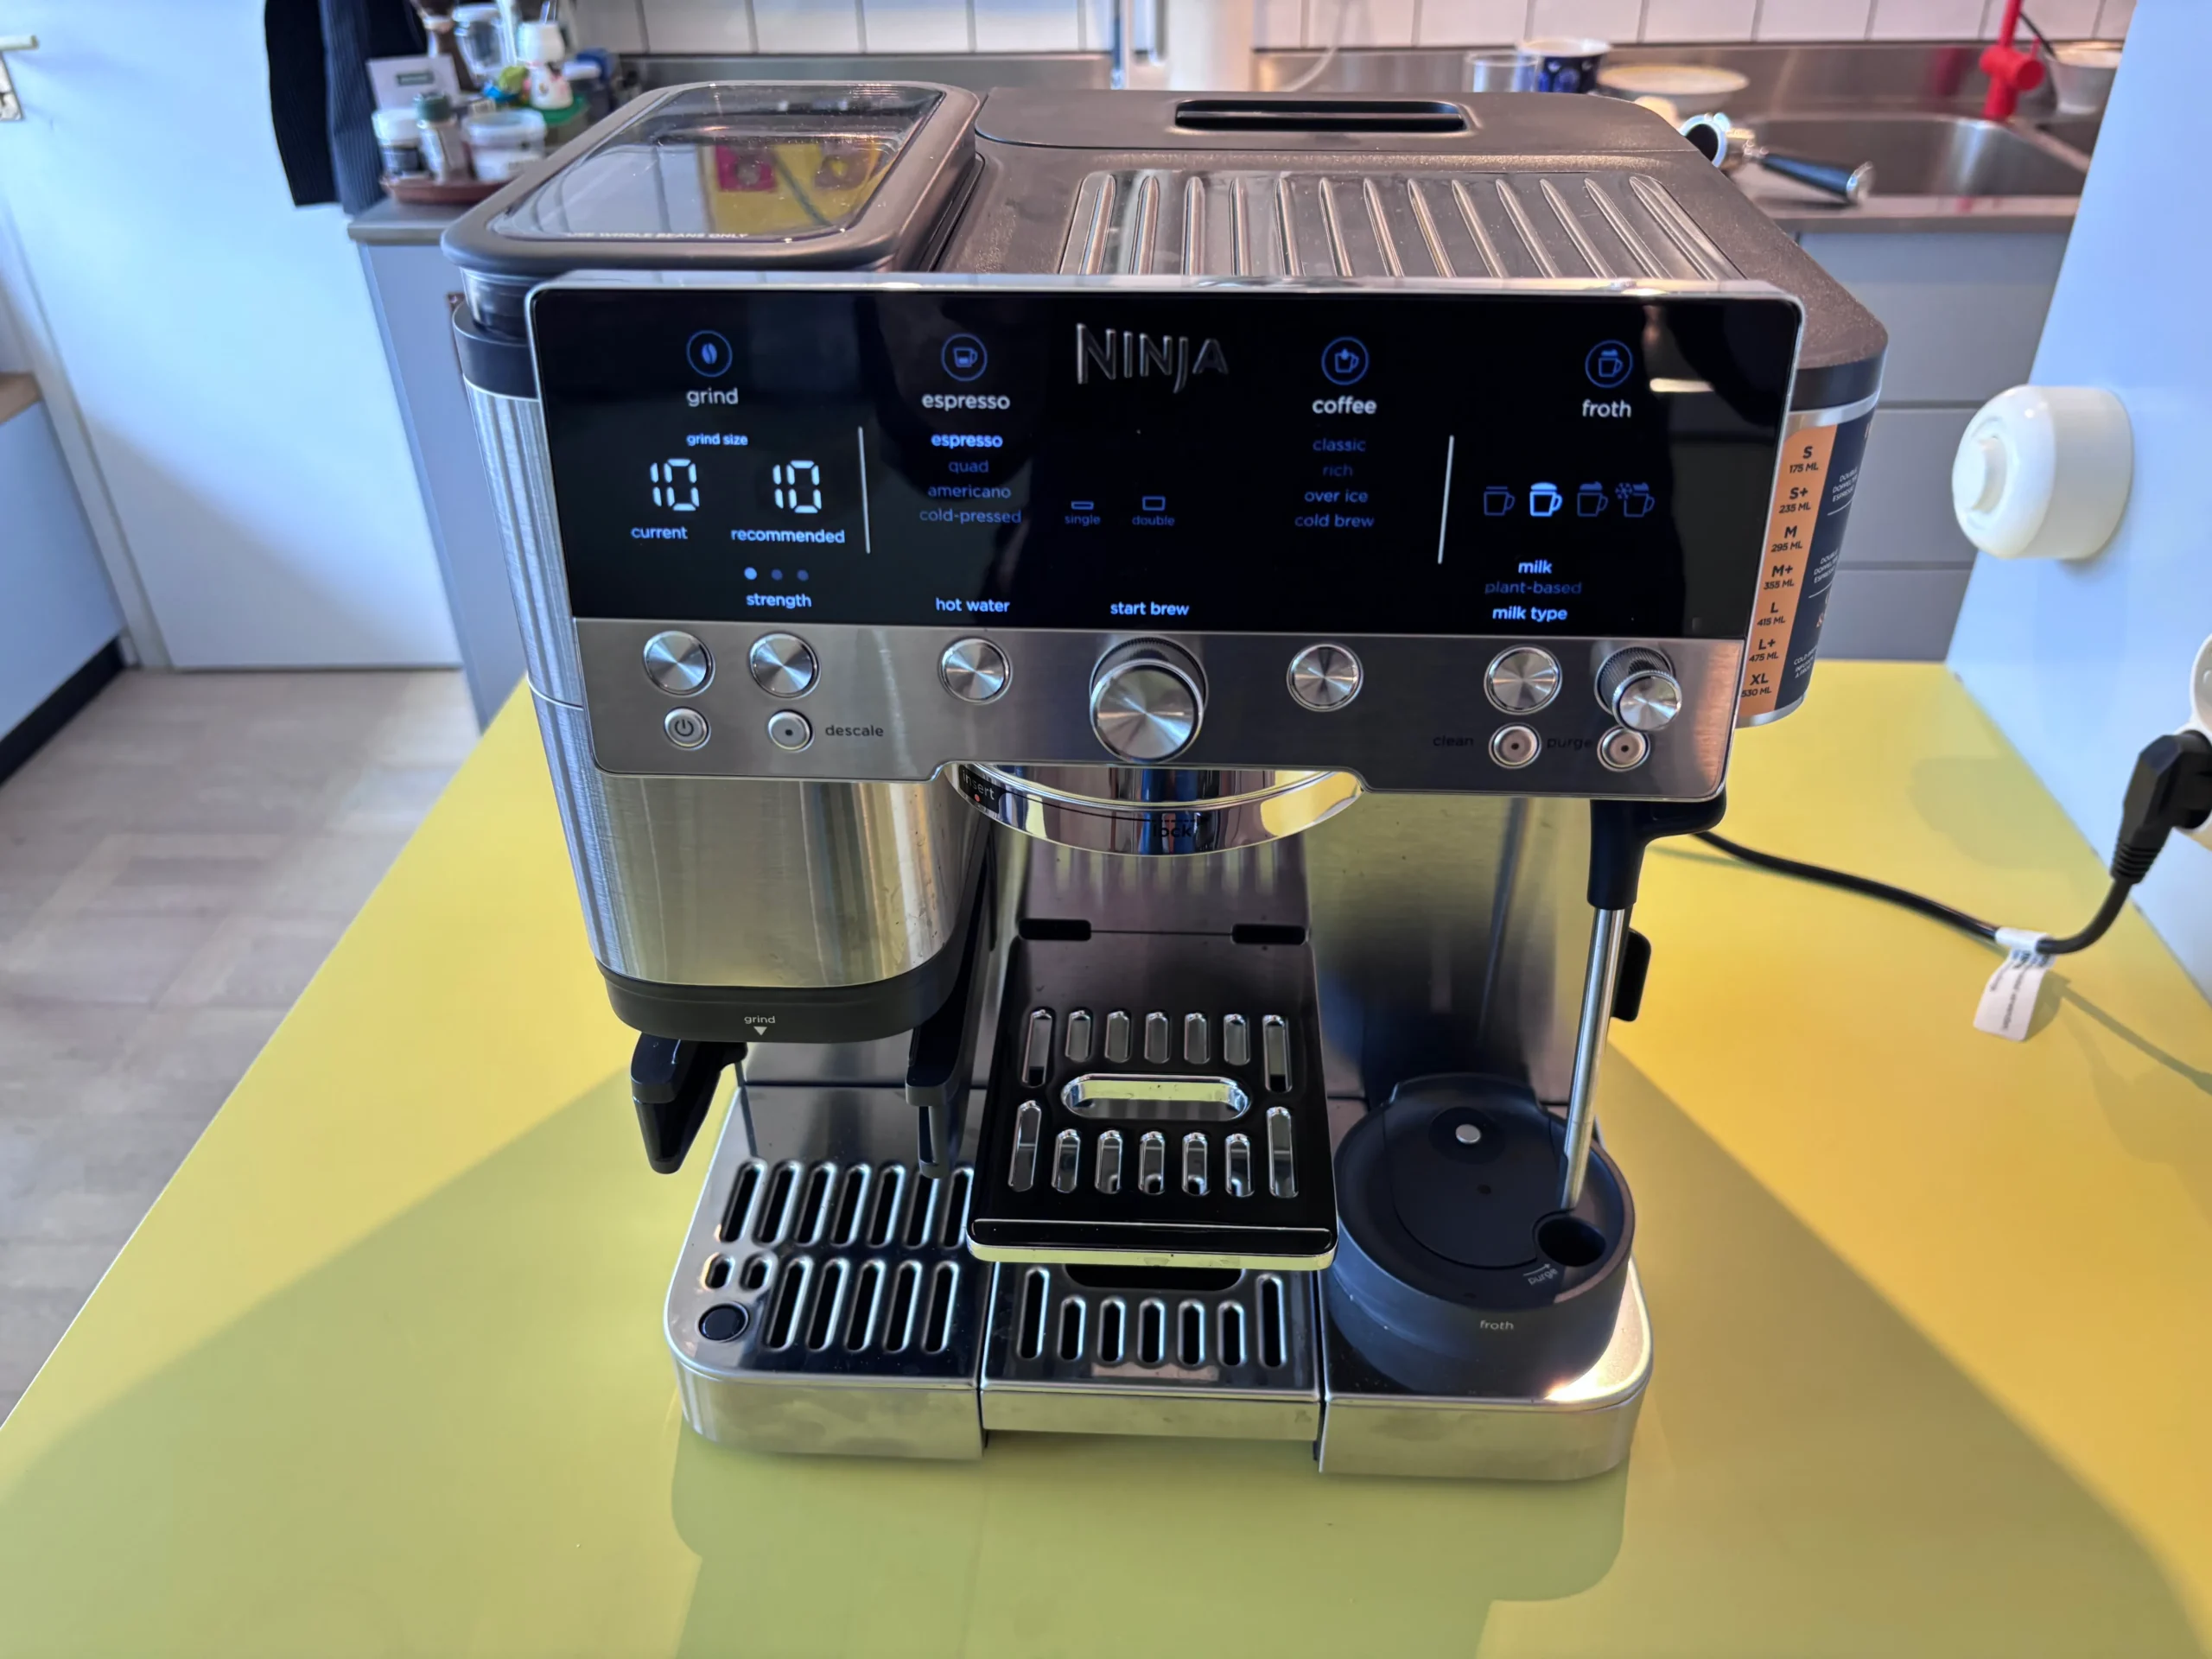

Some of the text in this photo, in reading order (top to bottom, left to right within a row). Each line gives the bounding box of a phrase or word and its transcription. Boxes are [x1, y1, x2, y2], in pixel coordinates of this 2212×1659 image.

[1076, 322, 1230, 394] NINJA
[686, 388, 739, 407] grind
[921, 393, 1011, 412] espresso
[1312, 395, 1377, 415] coffee
[1582, 399, 1632, 418] froth
[686, 432, 749, 447] grind size
[930, 434, 1004, 450] espresso
[1312, 437, 1367, 453] classic
[1802, 446, 1813, 459] S
[948, 459, 989, 474] quad
[1322, 463, 1354, 478] rich
[1789, 461, 1819, 474] 175 ML
[649, 458, 700, 512] 10
[771, 460, 823, 514] 10
[927, 485, 1013, 499] americano
[1304, 490, 1369, 504] over ice
[1789, 487, 1808, 499] S+
[1778, 501, 1811, 514] 235 ML
[919, 508, 1021, 524] cold-pressed
[1064, 514, 1101, 527] single
[1131, 514, 1176, 527] double
[1294, 512, 1375, 528] cold brew
[630, 526, 689, 540] current
[730, 528, 846, 544] recommended
[1784, 525, 1797, 538] M
[1770, 541, 1803, 552] 295 ML
[1517, 559, 1553, 575] milk
[1771, 564, 1793, 577] M+
[1484, 580, 1583, 595] plant-based
[1764, 578, 1795, 590] 355 ML
[746, 593, 813, 609] strength
[935, 596, 1011, 613] hot water
[1770, 602, 1779, 613] L
[1109, 601, 1190, 616] start brew
[1491, 605, 1568, 623] milk type
[1757, 616, 1786, 626] 415 ML
[1758, 639, 1776, 651] L+
[1749, 652, 1779, 663] 475 ML
[1750, 672, 1769, 686] XL
[1740, 686, 1772, 698] 530 ML
[825, 724, 884, 737] descale
[1433, 734, 1474, 747] clean
[1547, 738, 1592, 750] purge
[963, 769, 995, 801] insert
[1153, 824, 1192, 838] lock
[744, 1014, 776, 1025] grind
[1528, 1268, 1558, 1286] purge
[1479, 1319, 1515, 1331] froth
